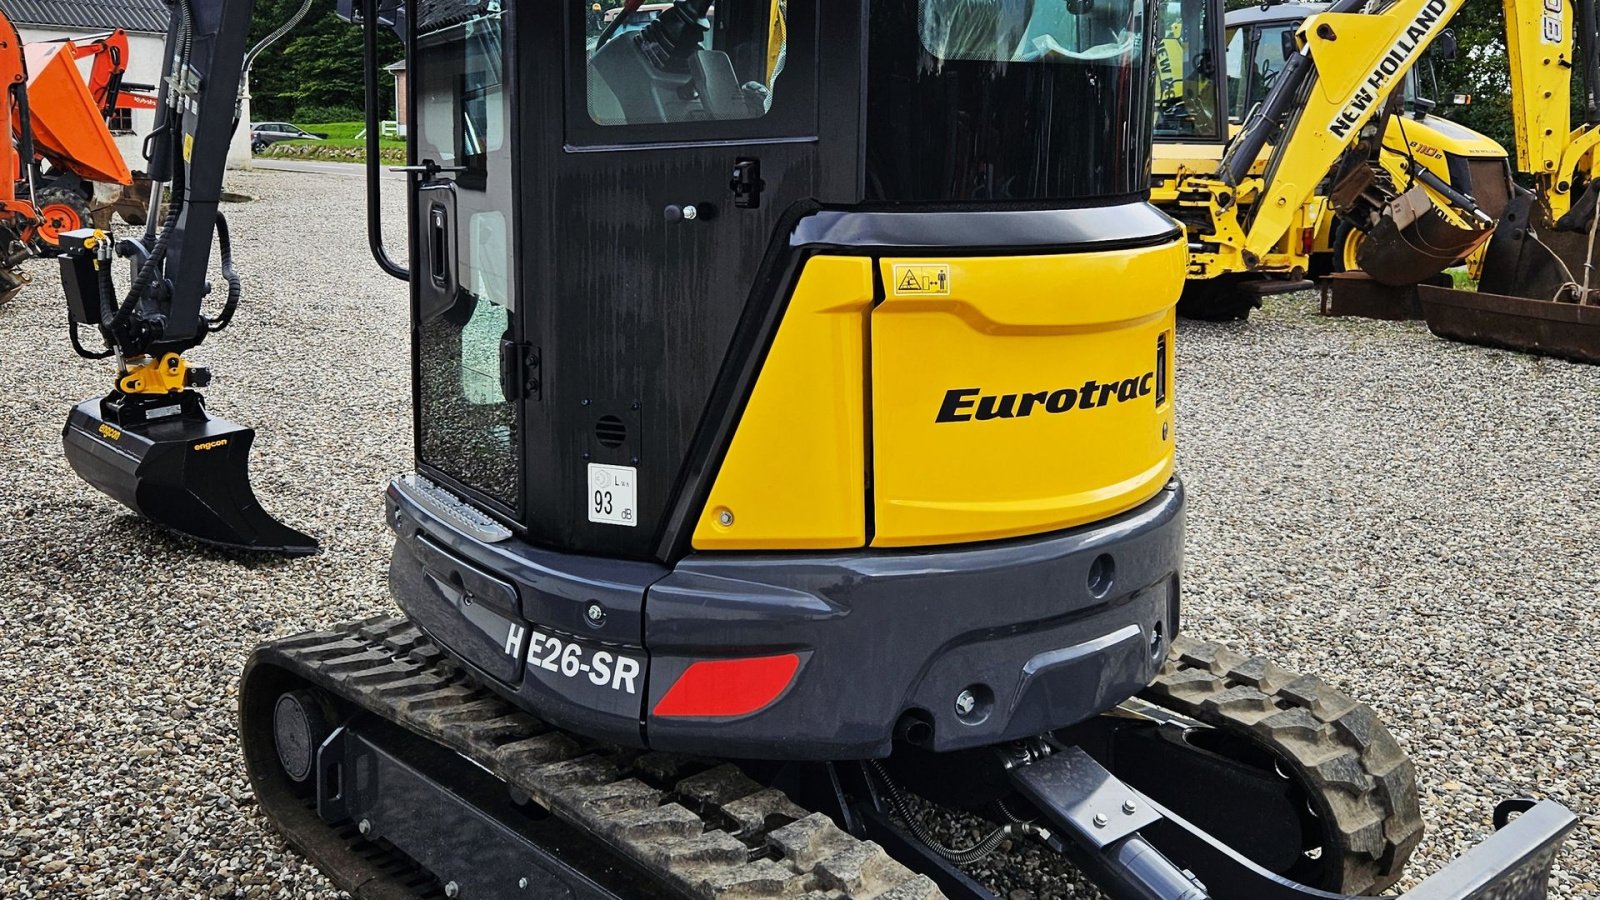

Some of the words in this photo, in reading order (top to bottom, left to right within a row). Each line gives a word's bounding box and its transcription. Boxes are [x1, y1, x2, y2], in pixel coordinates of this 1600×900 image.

[1329, 87, 1373, 138] NEW
[1367, 0, 1447, 90] HOLLAND
[934, 371, 1154, 424] Eurotrac
[99, 424, 121, 441] engcon
[194, 438, 228, 451] engcon
[594, 490, 613, 515] 93
[621, 508, 632, 520] dB
